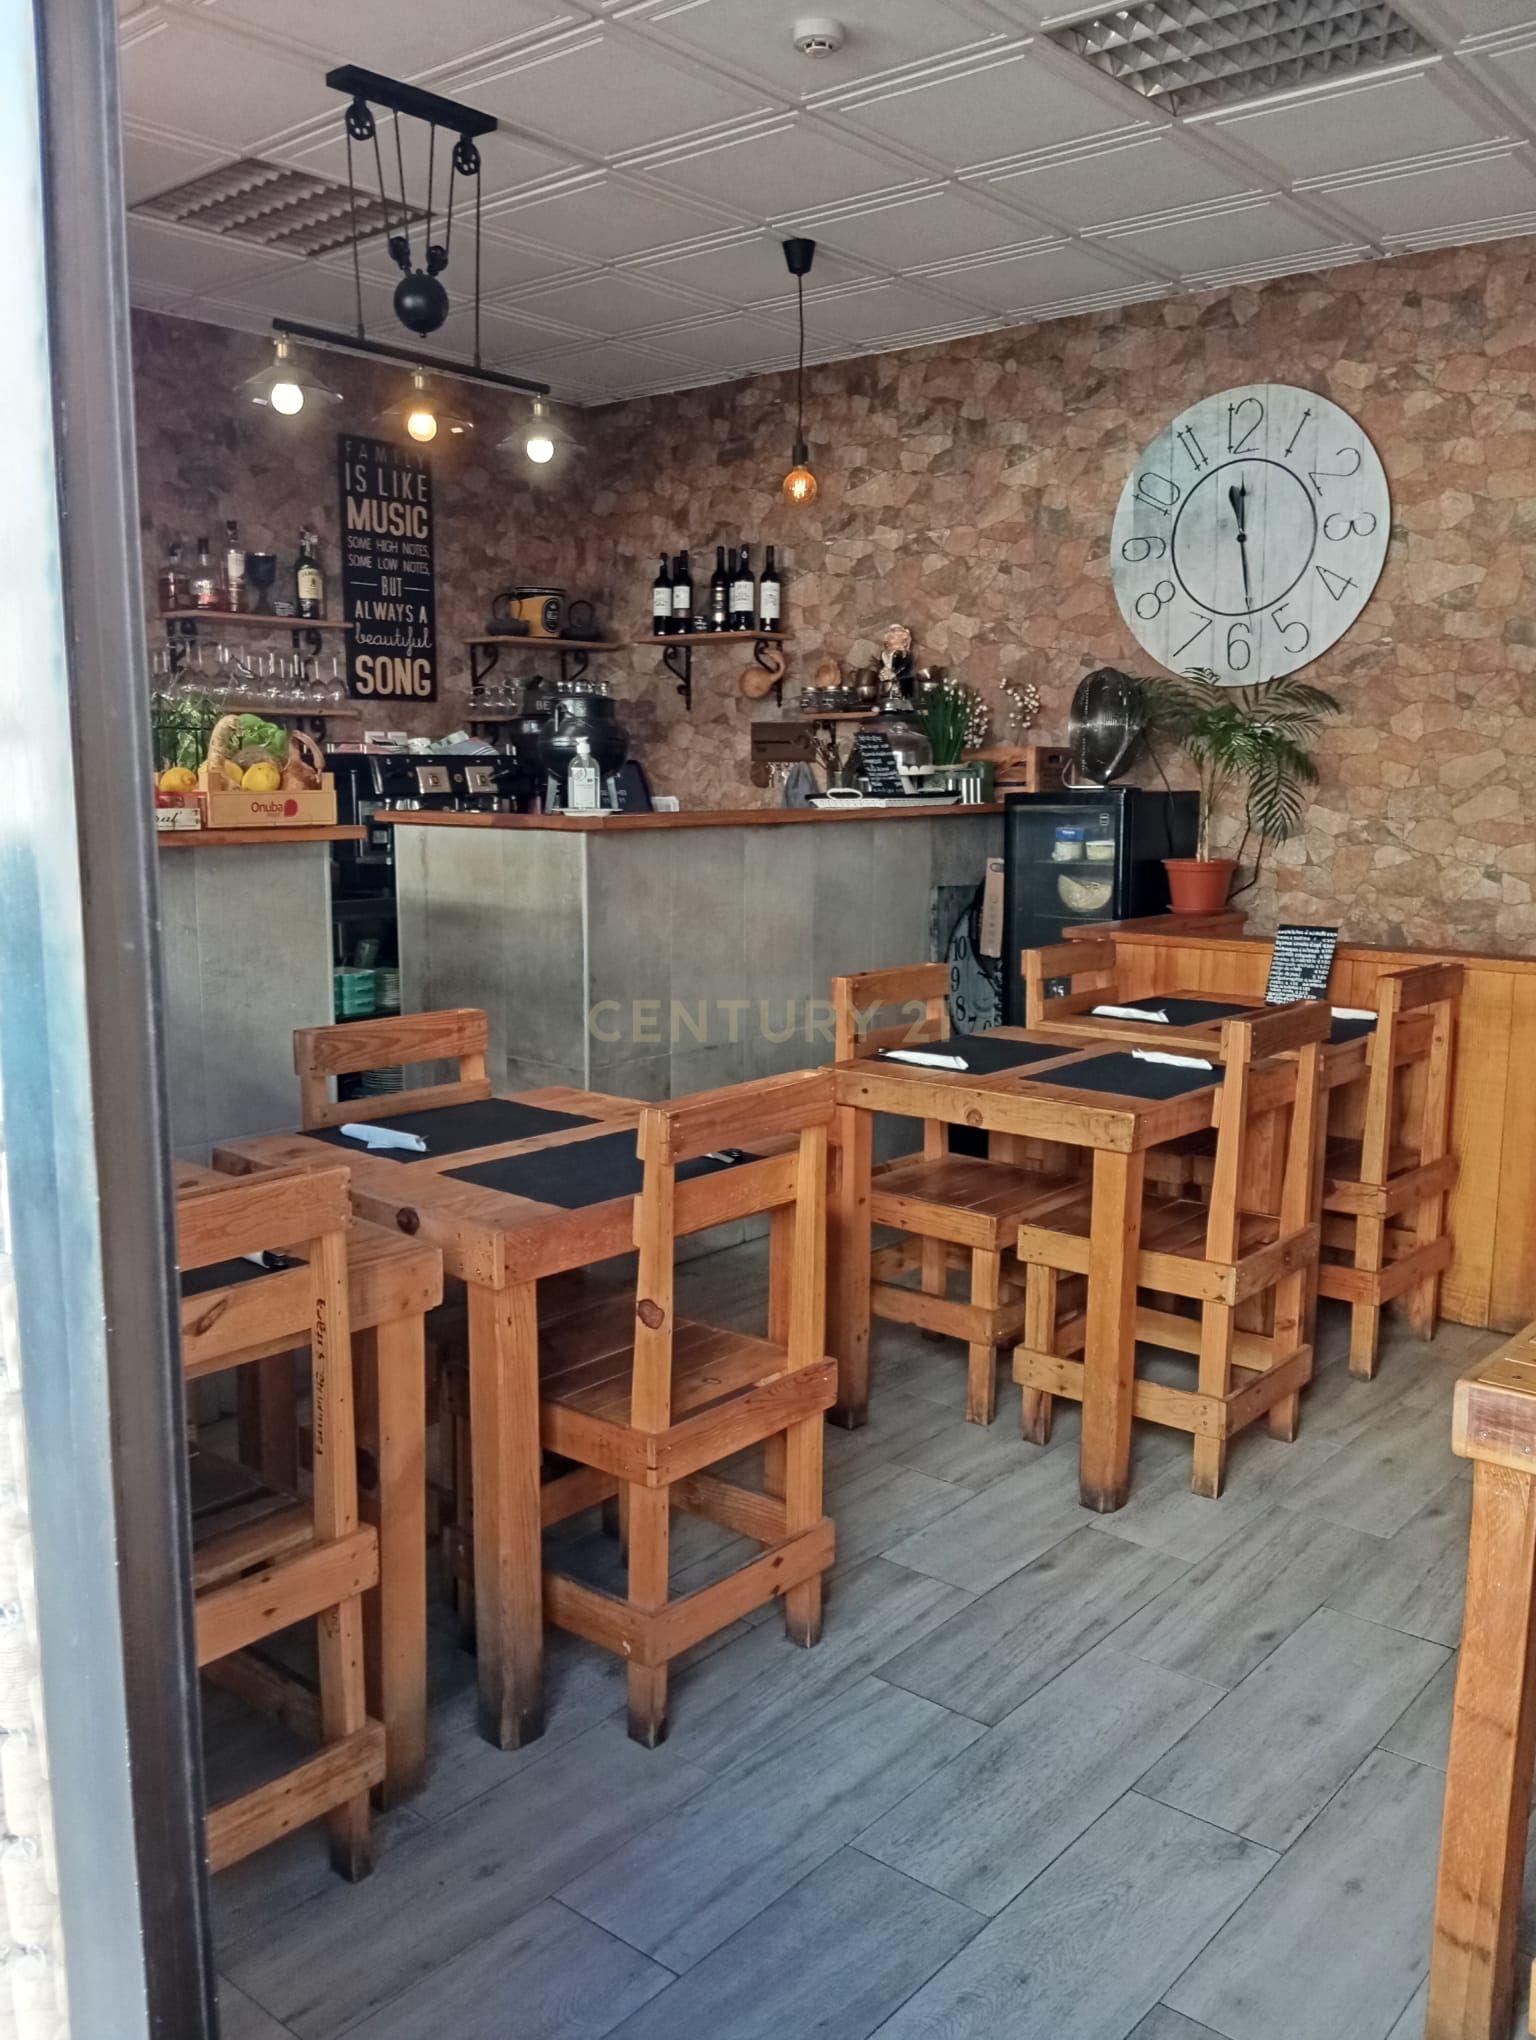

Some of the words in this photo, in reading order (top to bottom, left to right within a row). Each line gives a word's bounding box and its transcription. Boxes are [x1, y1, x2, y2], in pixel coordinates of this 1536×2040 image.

[1227, 397, 1264, 454] 12
[1284, 408, 1312, 458] 1
[1177, 424, 1209, 471] 11
[345, 462, 368, 493] IS
[378, 467, 428, 503] LIKE
[1308, 447, 1361, 497] 2
[1134, 472, 1181, 517] 10
[347, 496, 429, 539] MUSIC
[1323, 511, 1377, 541] 3
[347, 536, 372, 551] SOME
[376, 539, 398, 553] HIGH
[348, 554, 373, 568] SOME
[377, 558, 398, 572] LOW
[1122, 535, 1167, 562] 9
[381, 575, 402, 597] BUT
[1135, 580, 1176, 620] 8
[1315, 565, 1359, 601] 4
[355, 600, 414, 623] ALWAYS
[419, 605, 428, 624] A
[1271, 602, 1310, 653] 5
[355, 621, 433, 656] beautiful
[1173, 610, 1213, 657] 7
[1227, 622, 1251, 671] 6
[355, 654, 432, 697] SONG
[951, 936, 967, 962] 10
[951, 966, 960, 992] 9
[955, 995, 966, 1021] 8
